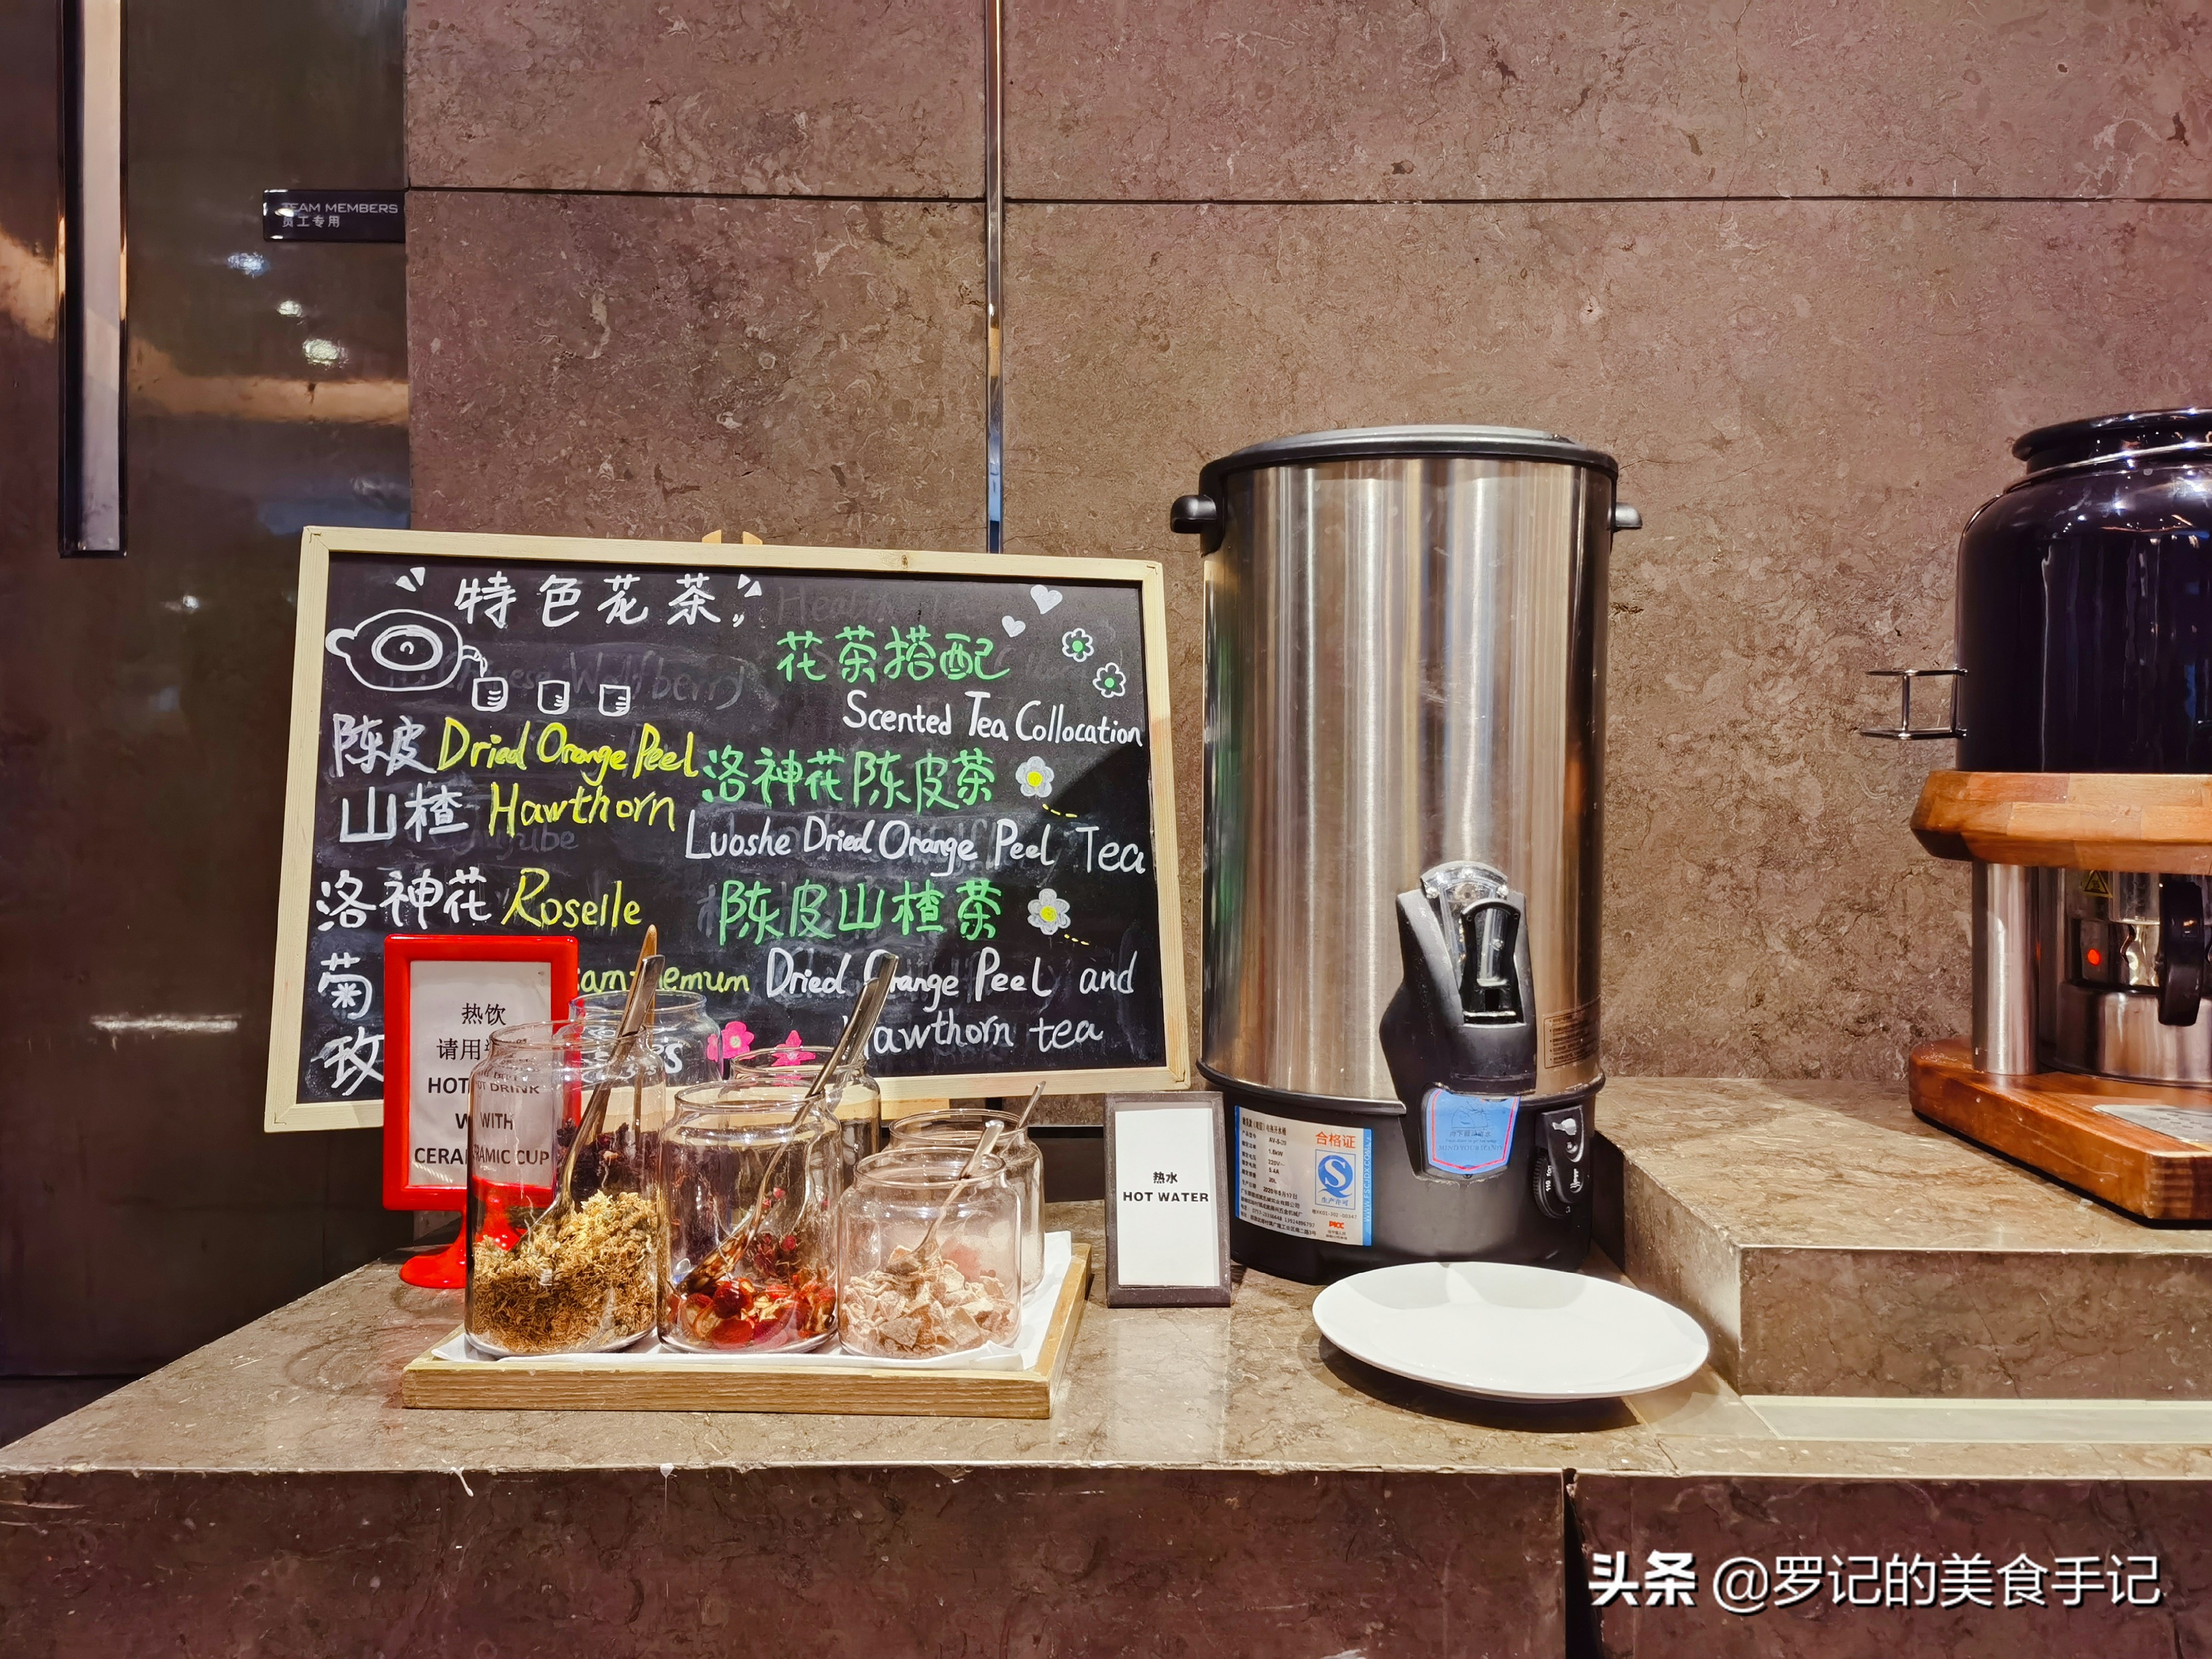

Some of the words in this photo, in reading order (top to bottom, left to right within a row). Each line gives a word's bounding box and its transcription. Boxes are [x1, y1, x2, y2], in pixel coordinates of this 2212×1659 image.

[282, 215, 341, 228] 员工专用
[325, 203, 398, 213] MEMBERS
[454, 571, 720, 629] 特色花茶
[777, 625, 1011, 682] 花茶搭配
[332, 713, 437, 777] 陈皮
[843, 690, 952, 737] Scented
[964, 691, 1009, 742] Tea
[1015, 700, 1143, 747] Collocation
[437, 716, 531, 771] Dried
[537, 722, 629, 786] Orange
[631, 723, 699, 779] Peel
[702, 746, 996, 814] 洛神花陈皮茶
[339, 781, 470, 843] 山楂
[489, 781, 676, 838] Hawthorn
[803, 815, 873, 854] Dried
[879, 820, 979, 877] Orange
[995, 819, 1054, 867] Peel
[1075, 826, 1146, 874] Tea
[316, 866, 493, 932] 洛神花
[500, 867, 642, 928] Roselle
[720, 879, 1003, 946] 陈皮山楂茶
[767, 947, 852, 997] Dried
[975, 946, 1053, 1002] Peel
[1079, 951, 1139, 995] and
[461, 1003, 506, 1026] 热饮
[843, 1007, 1013, 1059] awthorn
[1029, 1016, 1104, 1051] tea
[428, 1077, 469, 1093] HOT
[517, 1150, 550, 1165] CUP
[1315, 1131, 1356, 1149] 合格证
[1123, 1192, 1153, 1201] HOT
[1158, 1192, 1209, 1202] WATER
[1153, 1171, 1178, 1184] 热水
